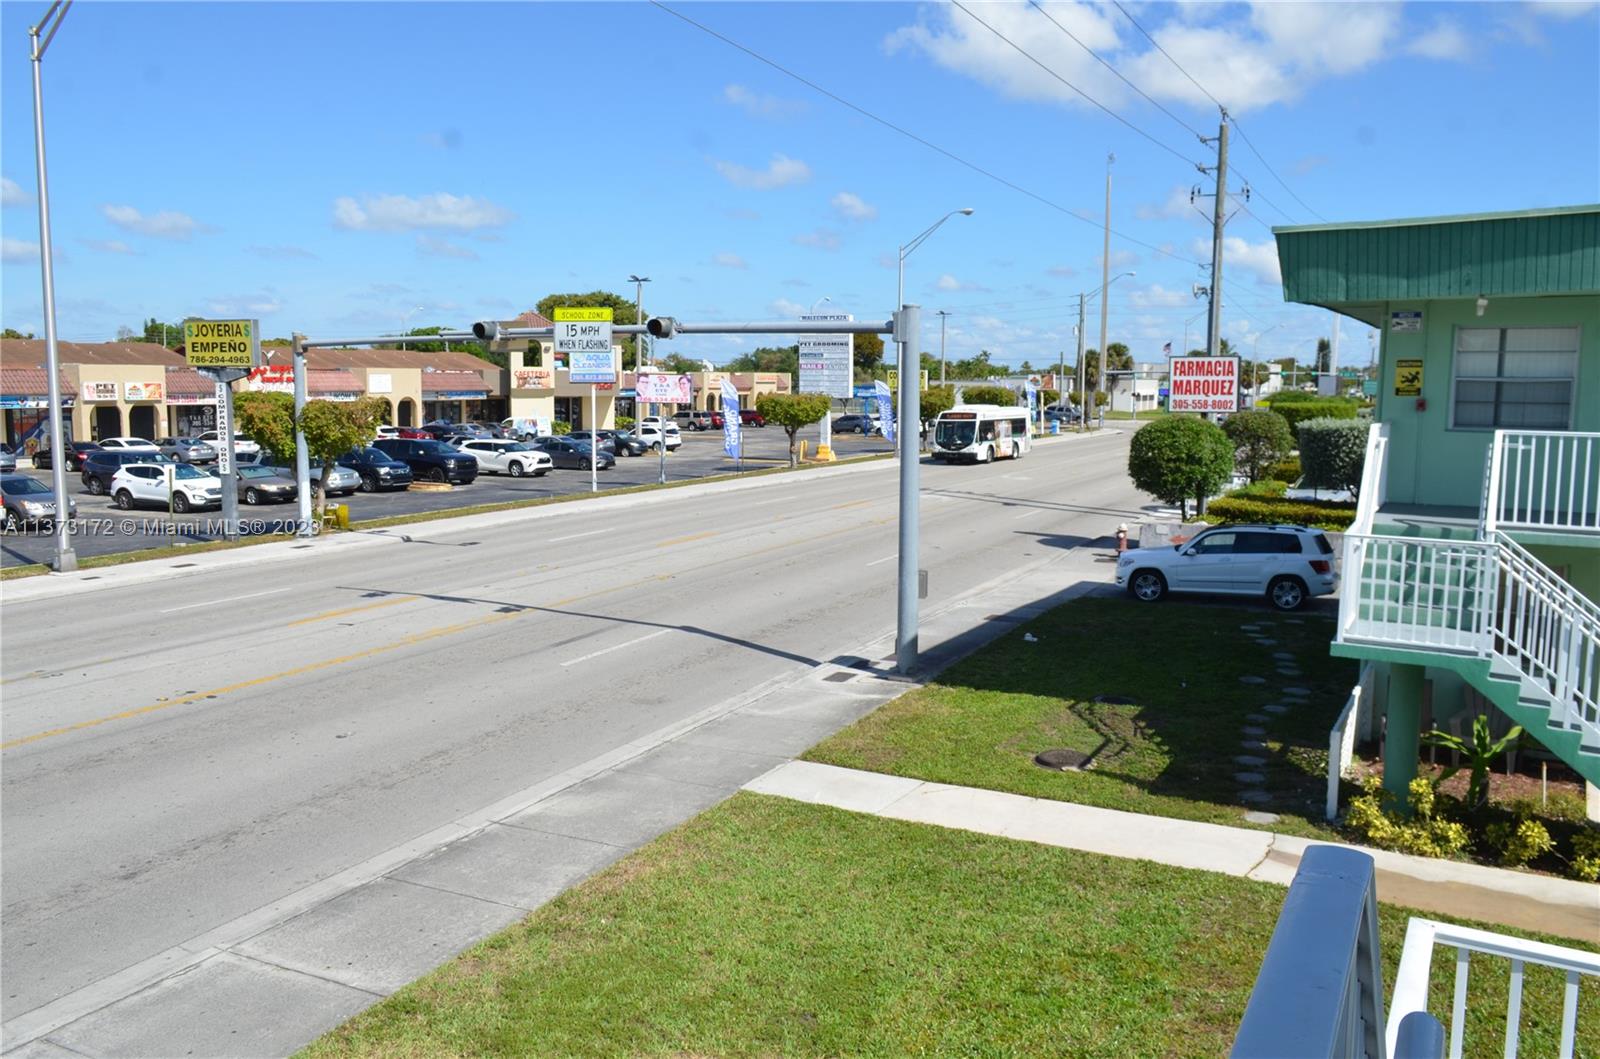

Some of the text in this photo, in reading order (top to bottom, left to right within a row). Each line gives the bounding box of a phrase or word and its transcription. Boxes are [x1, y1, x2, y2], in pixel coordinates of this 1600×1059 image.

[566, 324, 600, 337] 15 MPH
[191, 339, 247, 353] EMPEÑO
[559, 339, 608, 350] WHEN FLASHING
[190, 356, 250, 364] 786-294-4963
[586, 354, 610, 362] AQUA
[1173, 360, 1234, 376] FARMACIA
[1173, 380, 1234, 397] MARQUEZ
[1172, 399, 1234, 409] 305-558-8002
